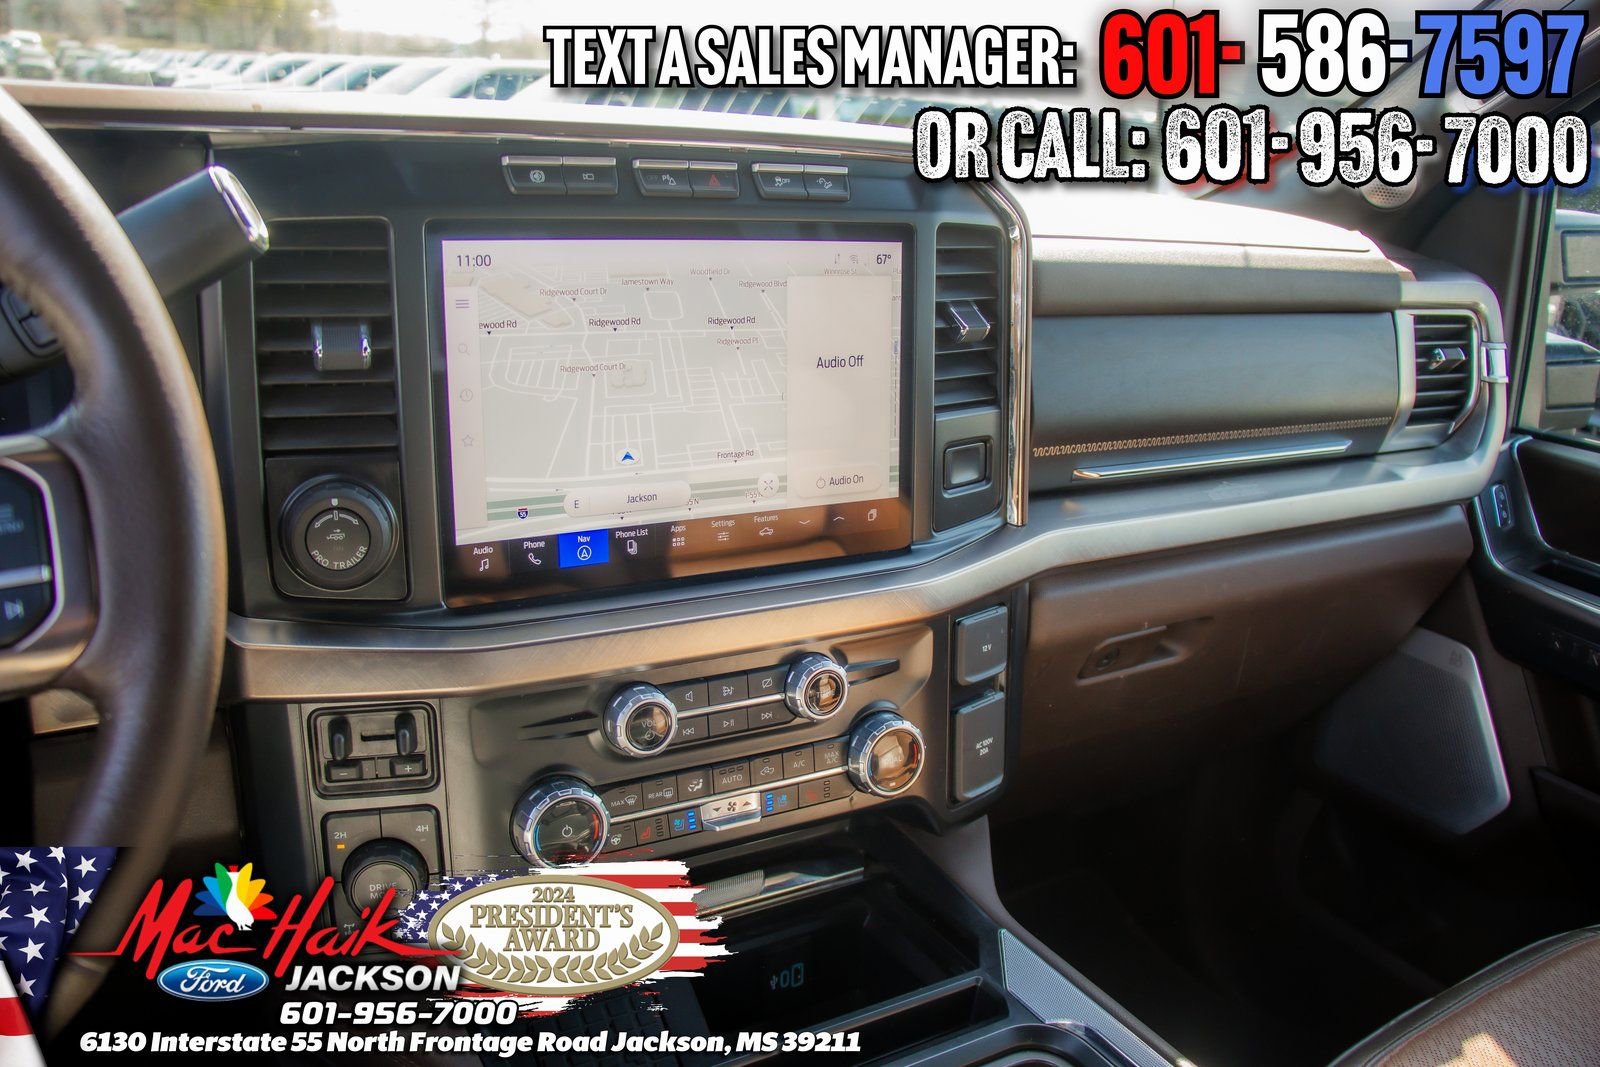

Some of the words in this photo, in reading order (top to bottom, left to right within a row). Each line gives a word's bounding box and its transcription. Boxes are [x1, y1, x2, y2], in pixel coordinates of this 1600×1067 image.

[457, 254, 492, 267] 11:00
[660, 278, 674, 286] Way
[738, 280, 772, 288] Ridgewood
[540, 288, 579, 297] Ridgewood
[580, 288, 598, 296] Court
[506, 320, 517, 328] Rd
[588, 318, 630, 328] Ridgewood
[630, 318, 641, 326] Rd
[708, 316, 746, 326] Ridgewood
[746, 316, 756, 324] Rd
[717, 338, 750, 346] Ridgewood
[816, 355, 846, 368] Audio
[848, 354, 864, 368] Off
[560, 364, 598, 374] Ridgewood
[600, 363, 618, 372] Court
[717, 451, 744, 460] Frontage
[745, 450, 754, 458] Rd
[829, 476, 852, 486] Audio
[852, 474, 864, 484] On
[626, 492, 658, 504] Jackson
[574, 500, 580, 508] E
[711, 518, 736, 528] Settings
[754, 514, 779, 523] Features
[616, 530, 636, 538] Phone
[636, 528, 648, 537] List
[670, 524, 686, 534] Apps
[524, 540, 546, 550] Phone
[473, 546, 494, 555] Audio
[311, 550, 330, 567] PRO
[332, 546, 368, 570] TRAILER
[824, 750, 840, 759] MAX
[793, 760, 806, 768] A/C
[722, 774, 743, 784] AUTO
[648, 792, 663, 800] REAR
[334, 832, 347, 840] 2H
